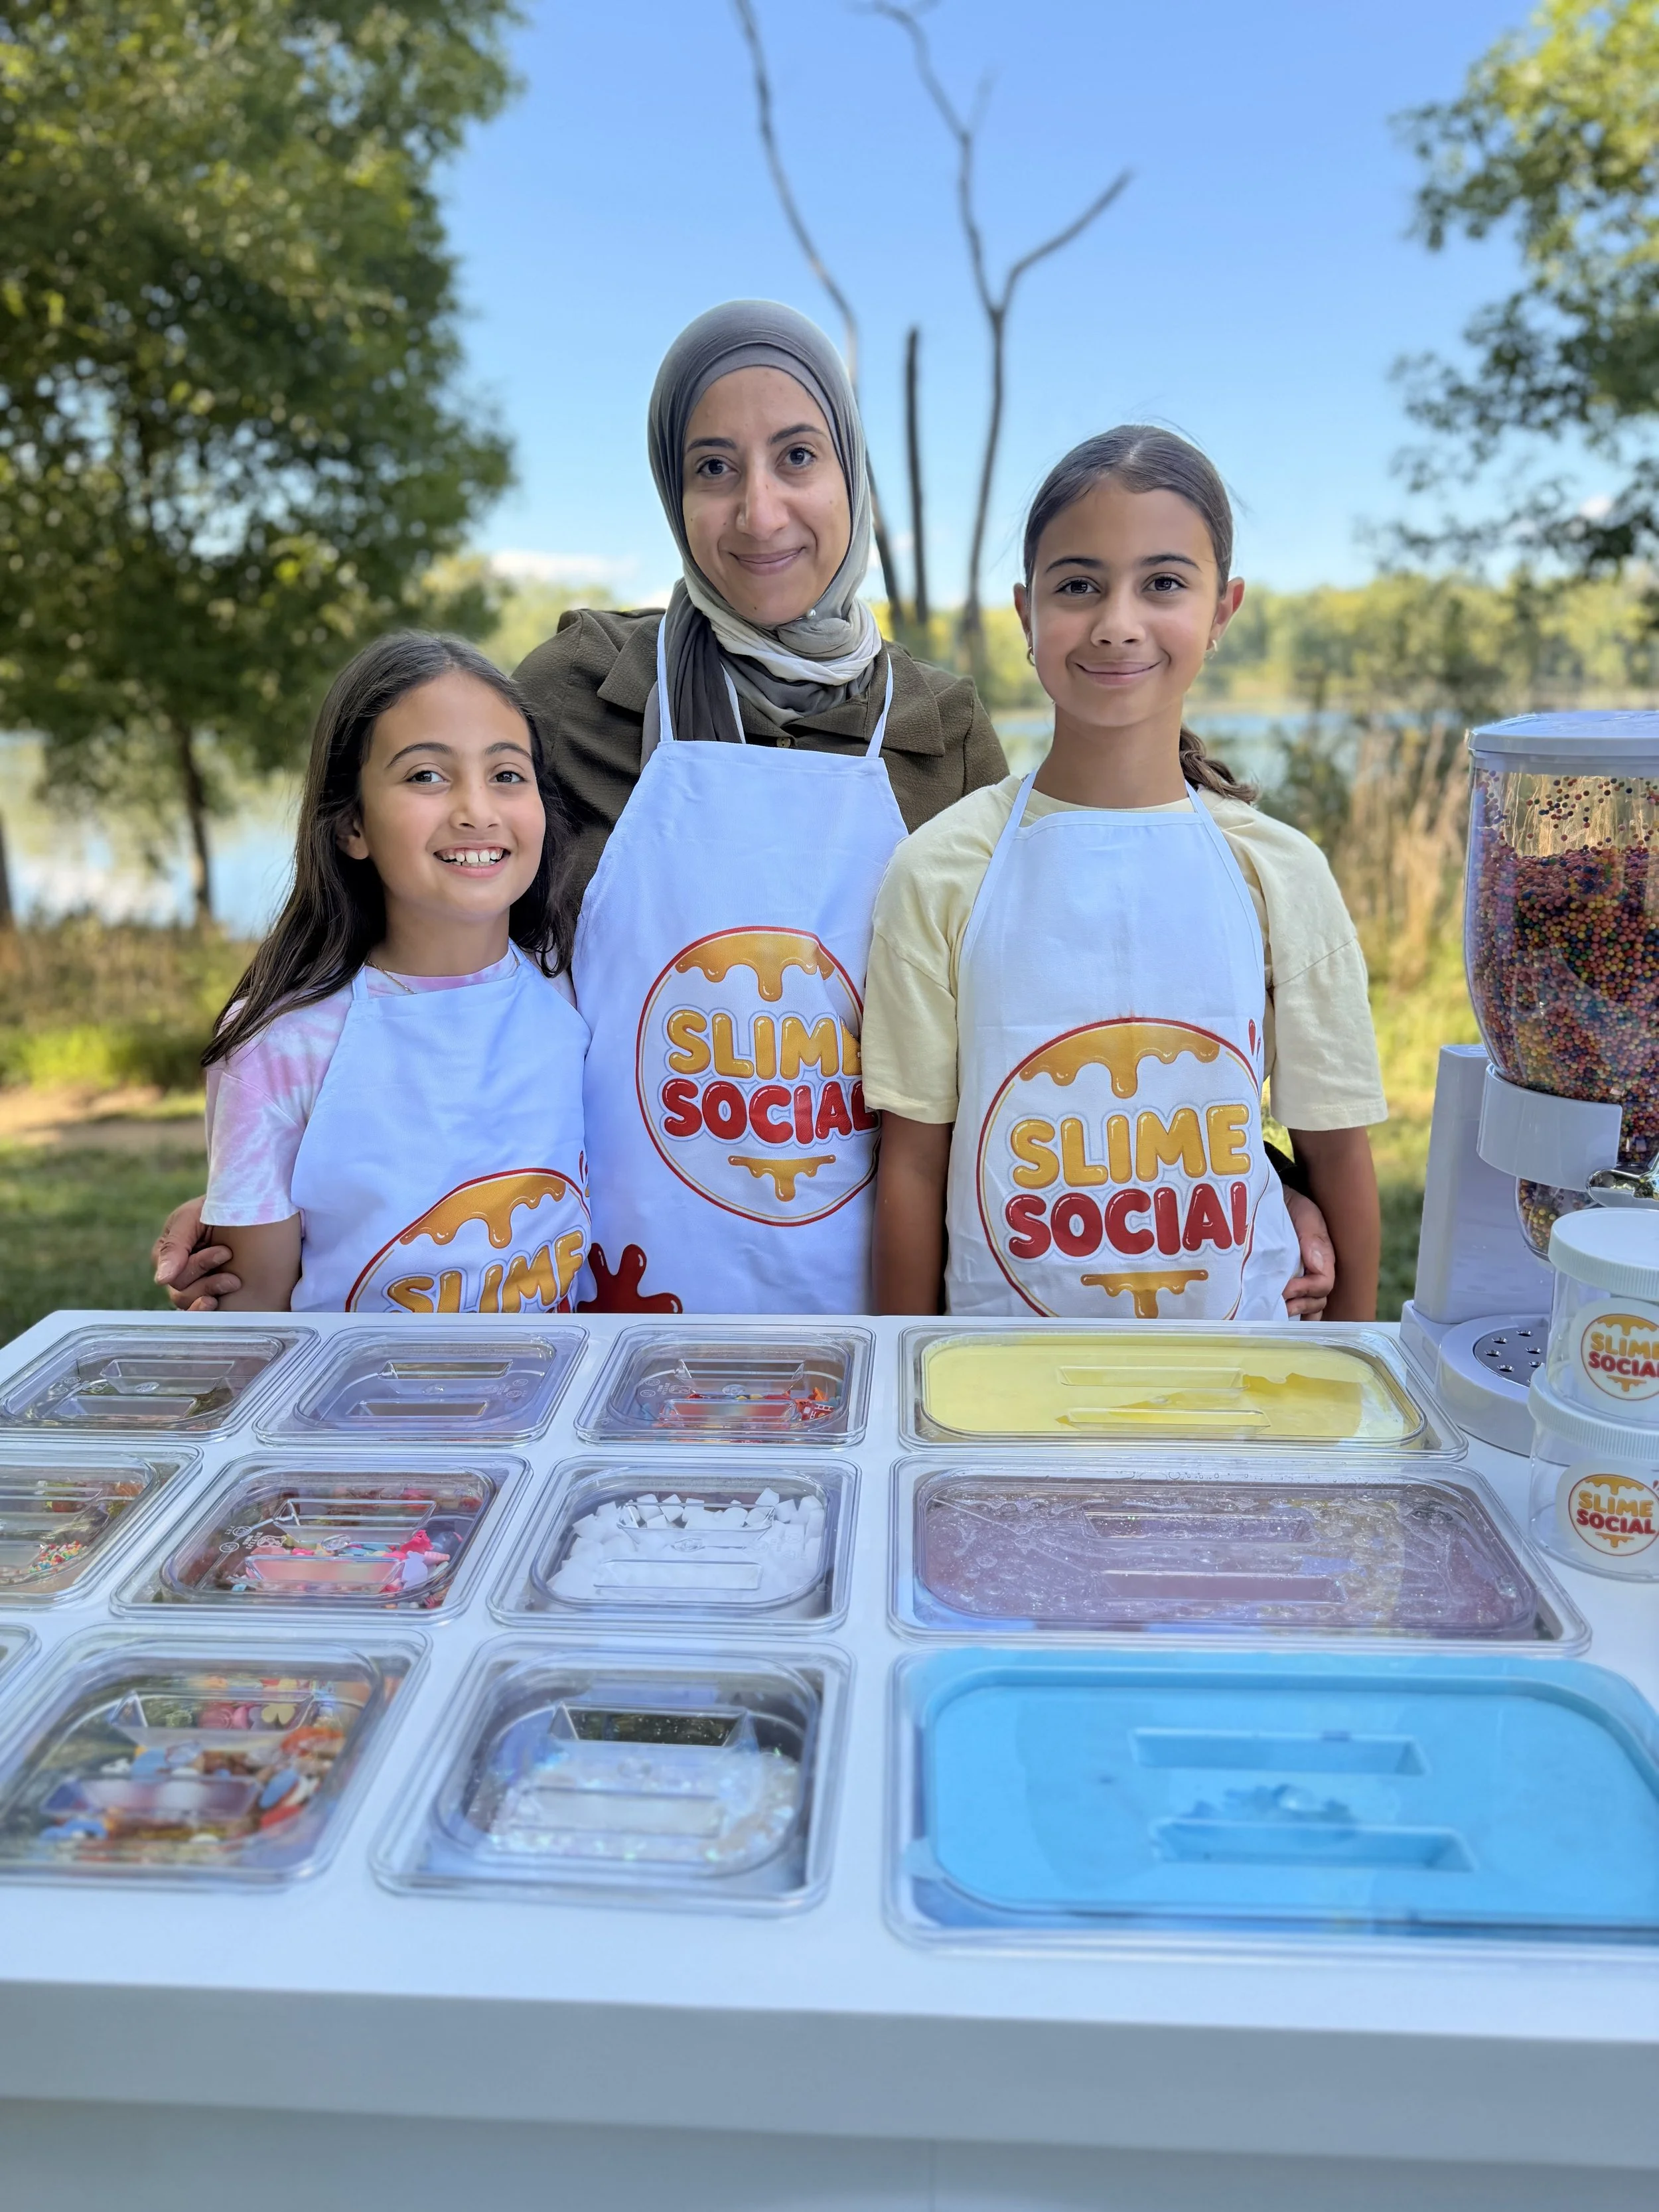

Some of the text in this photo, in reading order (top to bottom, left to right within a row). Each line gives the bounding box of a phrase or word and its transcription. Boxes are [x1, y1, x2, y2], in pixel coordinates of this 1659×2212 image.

[662, 1078, 879, 1145] SOCIAL
[1010, 1104, 1251, 1189] SLIME
[1589, 1351, 1659, 1378] SOCIA
[1579, 1490, 1654, 1517] SLIME
[1576, 1508, 1656, 1534] SOCIAL
